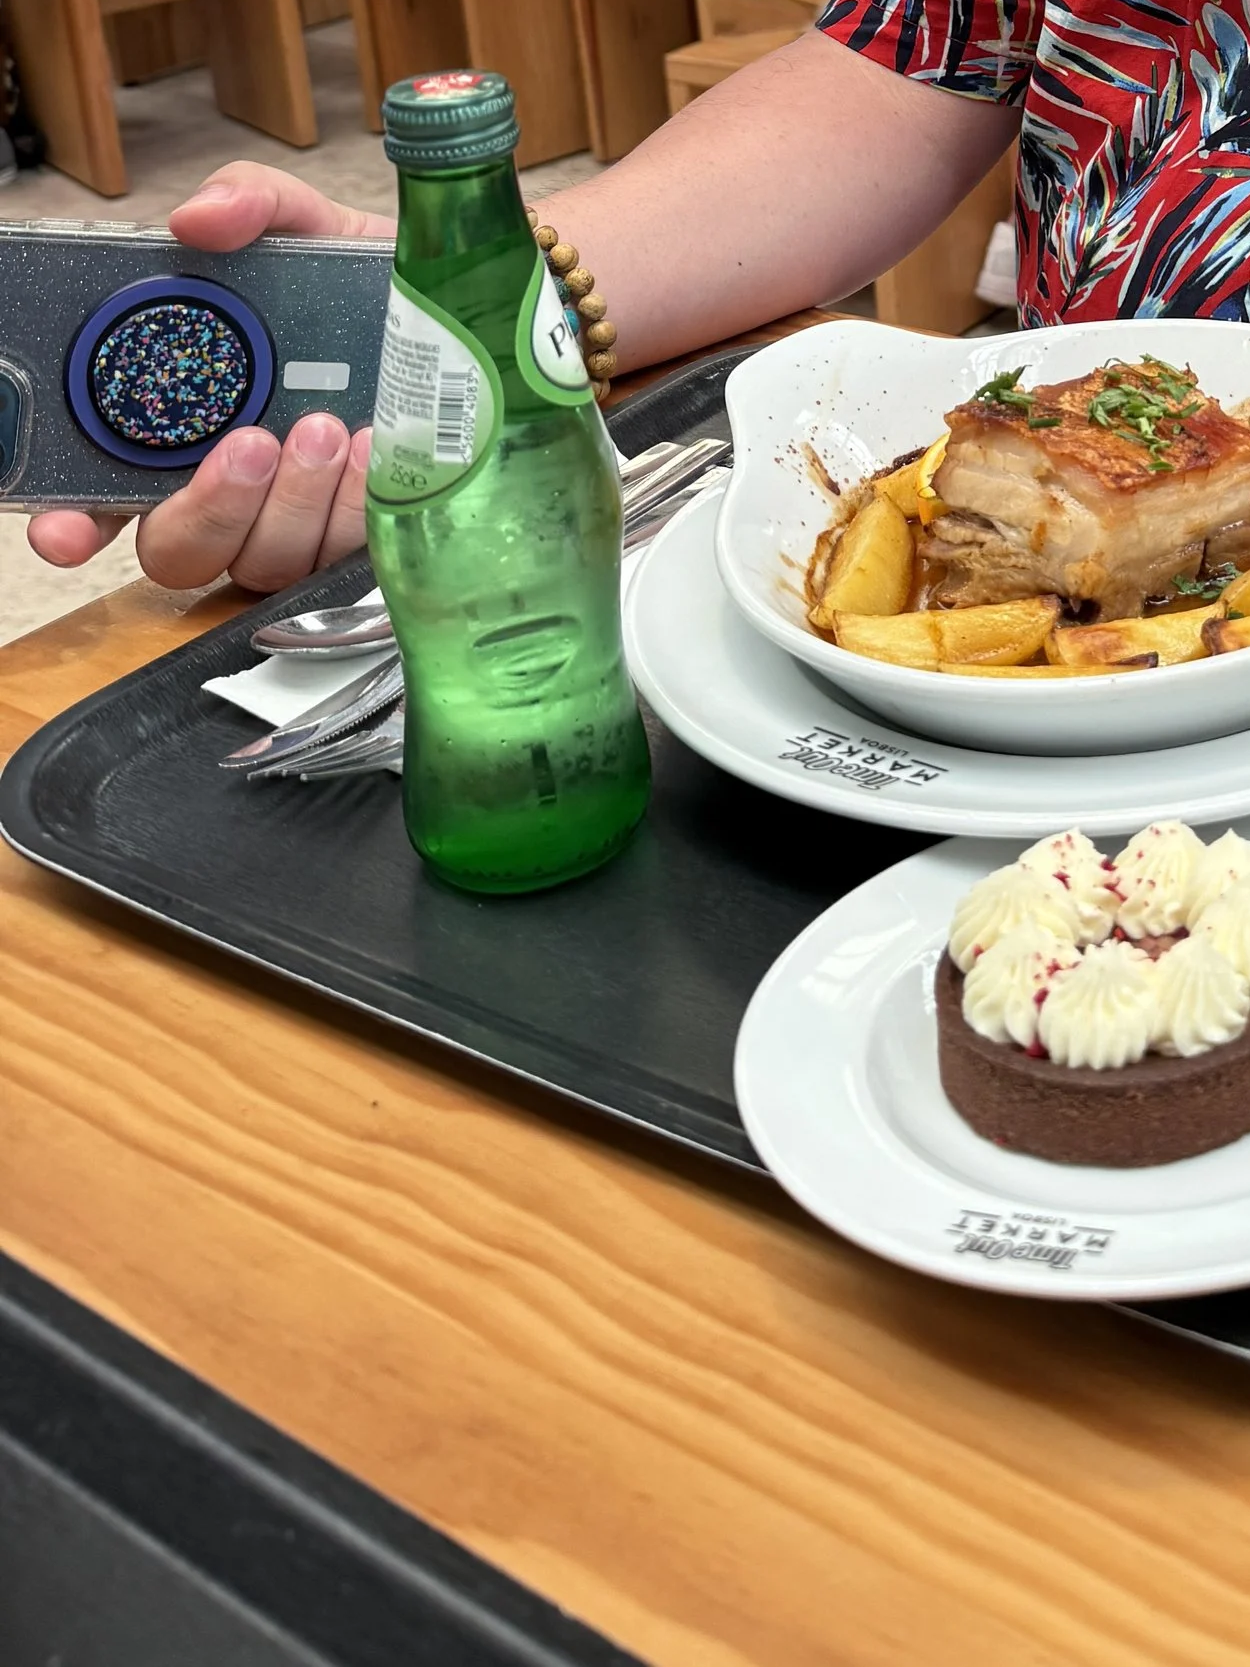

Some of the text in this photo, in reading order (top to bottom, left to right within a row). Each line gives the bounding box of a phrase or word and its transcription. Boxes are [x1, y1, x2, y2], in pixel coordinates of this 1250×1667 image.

[796, 732, 940, 783] MARKET
[860, 737, 908, 757] LISBOA
[952, 1215, 1110, 1248] MARKET
